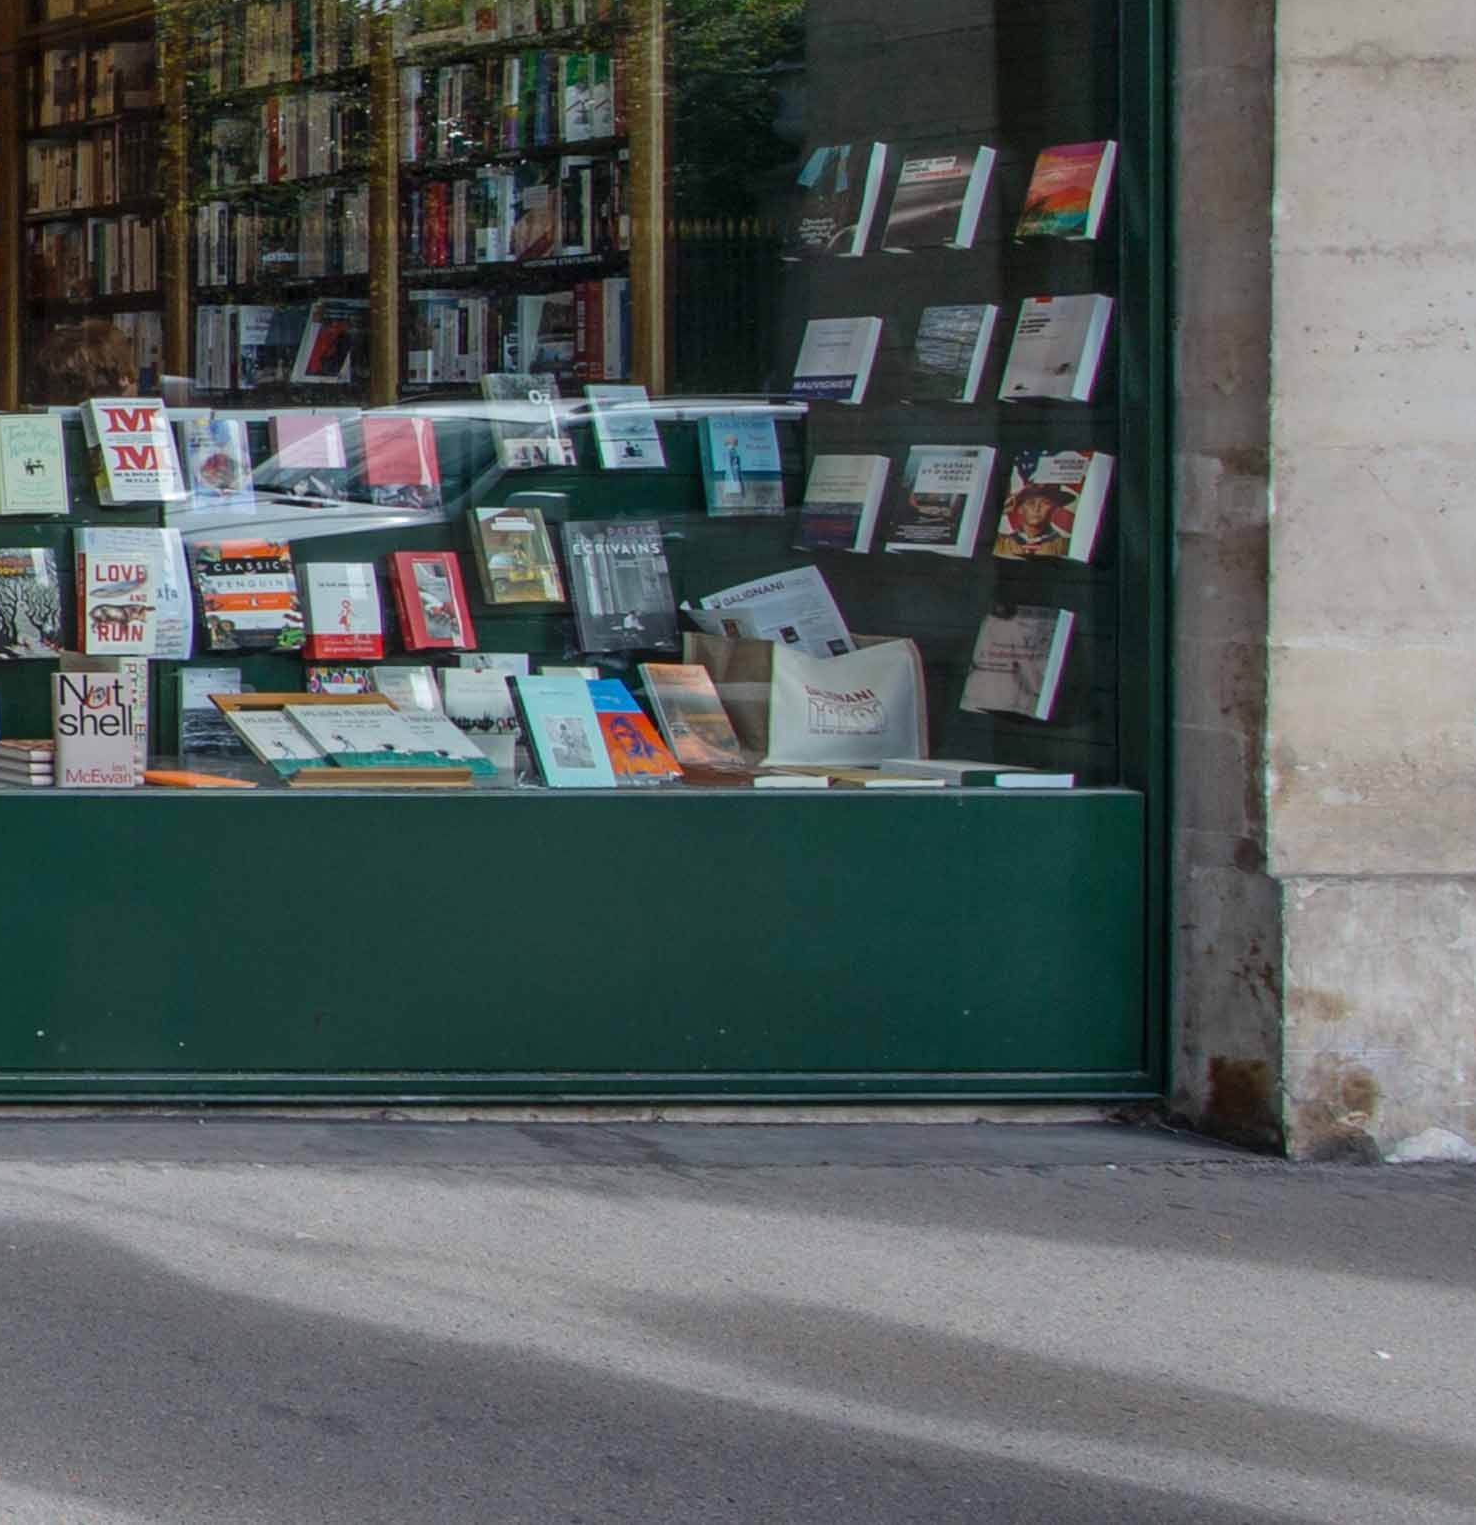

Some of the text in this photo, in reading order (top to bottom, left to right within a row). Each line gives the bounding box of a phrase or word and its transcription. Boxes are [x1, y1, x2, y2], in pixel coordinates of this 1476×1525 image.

[528, 389, 552, 405] Oz
[99, 407, 163, 432] M
[95, 564, 147, 583] LOVE
[213, 562, 281, 572] CLASSIC
[217, 579, 284, 588] PENGUIN
[722, 580, 785, 606] GALIGNANI
[97, 622, 144, 642] RUIN
[58, 674, 125, 709] Nut
[58, 705, 133, 737] shell
[65, 768, 132, 784] McEwan
